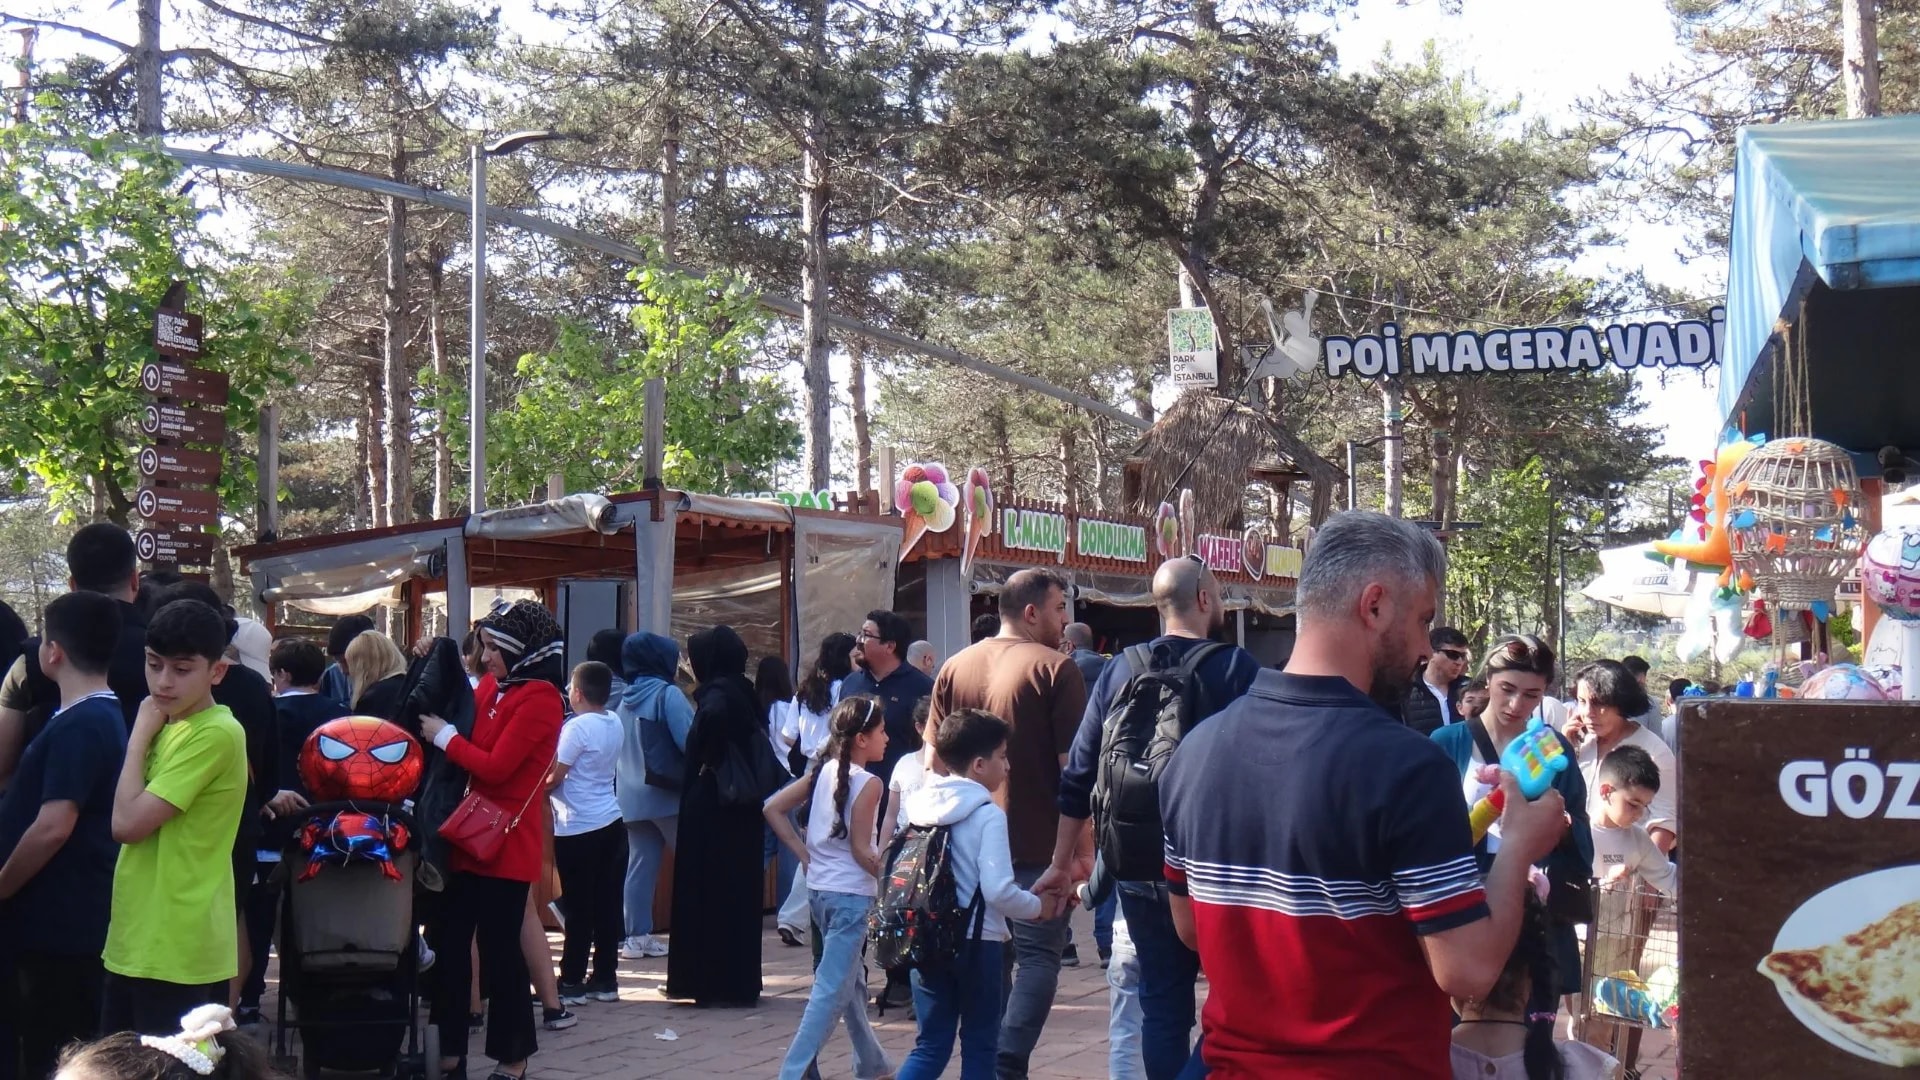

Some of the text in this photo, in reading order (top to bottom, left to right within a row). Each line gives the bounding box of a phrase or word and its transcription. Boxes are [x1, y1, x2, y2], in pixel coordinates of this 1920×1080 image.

[174, 317, 189, 328] PARK
[174, 326, 183, 334] OF
[1173, 355, 1196, 363] PARK
[1411, 328, 1600, 375] MACERA
[1174, 364, 1186, 372] OF
[1078, 518, 1147, 562] DONDURMA
[1199, 534, 1240, 572] WAFFLE
[1778, 747, 1920, 820] GÖZ
